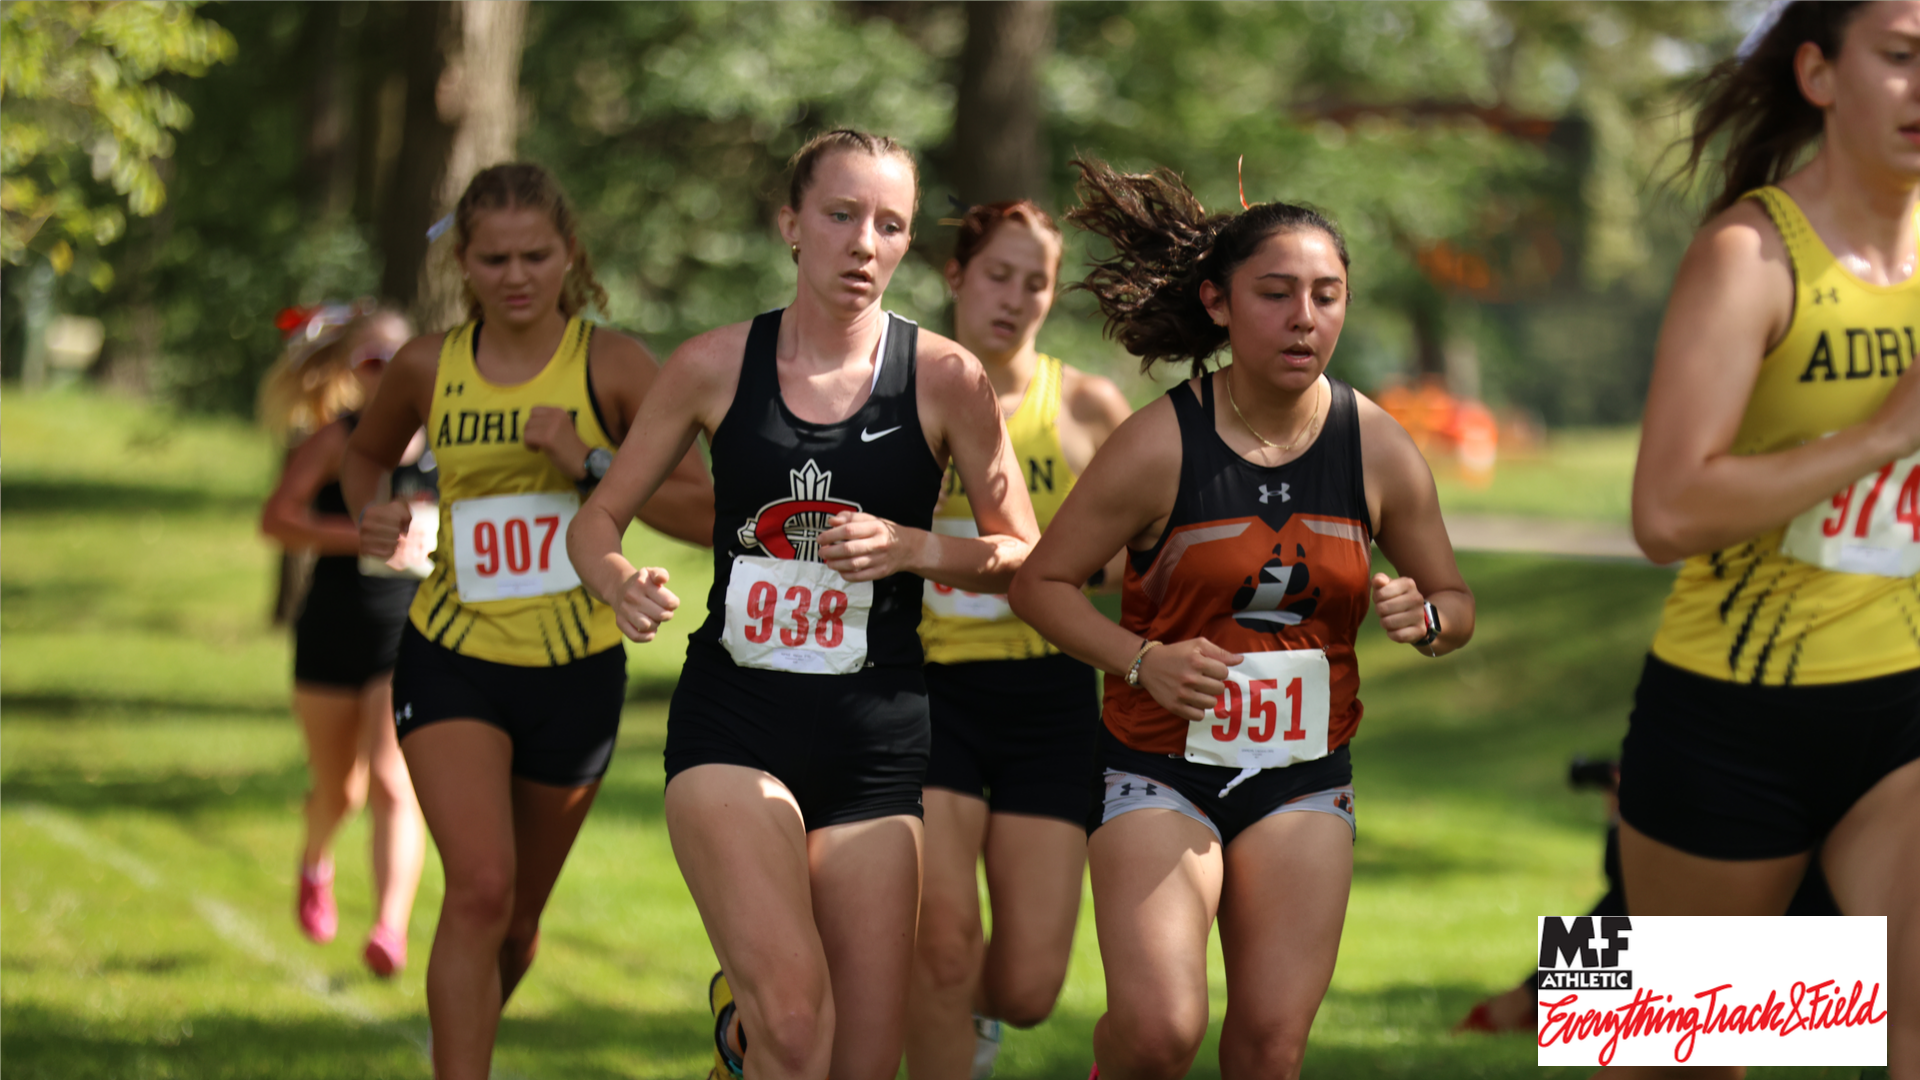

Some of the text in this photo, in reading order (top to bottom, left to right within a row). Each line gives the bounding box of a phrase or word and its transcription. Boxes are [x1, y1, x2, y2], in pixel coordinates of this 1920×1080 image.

[473, 514, 560, 578] 907
[744, 580, 848, 648] 938
[1211, 677, 1306, 743] 951
